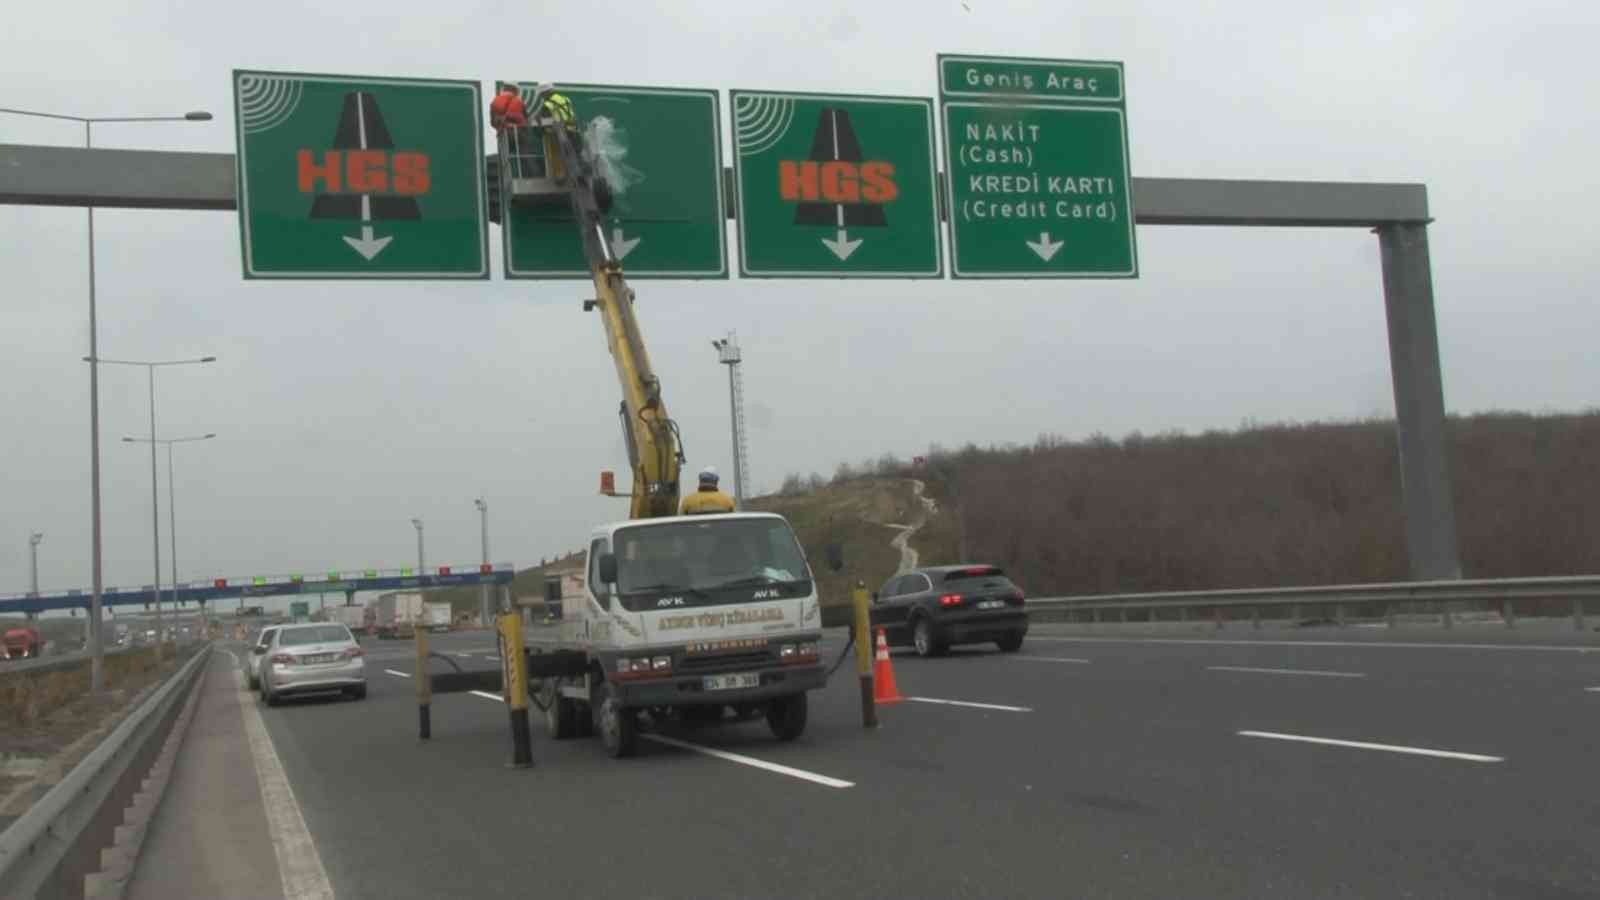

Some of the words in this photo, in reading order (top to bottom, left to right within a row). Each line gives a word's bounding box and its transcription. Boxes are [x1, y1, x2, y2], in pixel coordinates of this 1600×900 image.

[966, 69, 1034, 88] Geniş
[1046, 72, 1099, 92] Araç
[966, 121, 1040, 142] NAKİT
[960, 146, 1033, 167] (Cash)
[297, 149, 432, 196] HGS
[778, 160, 899, 204] HGS
[970, 172, 1039, 193] KREDİ
[1048, 177, 1114, 194] KARTI
[1056, 202, 1117, 222] Card)
